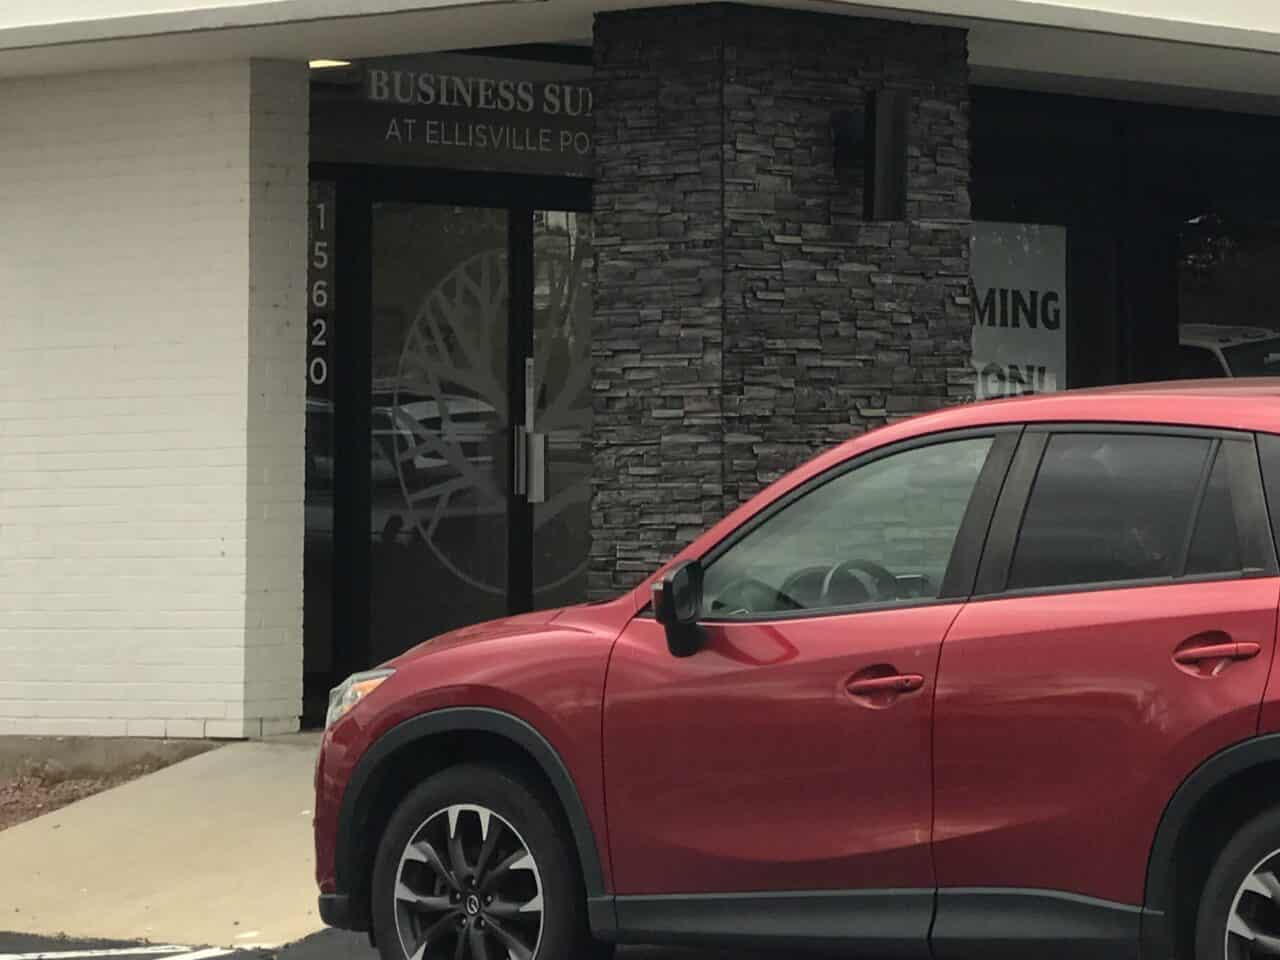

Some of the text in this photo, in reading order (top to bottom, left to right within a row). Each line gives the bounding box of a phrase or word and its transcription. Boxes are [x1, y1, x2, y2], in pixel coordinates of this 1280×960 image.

[367, 69, 592, 117] BUSINESS SUI
[385, 118, 590, 155] AT ELLISVILLE PO
[975, 288, 1061, 330] MING
